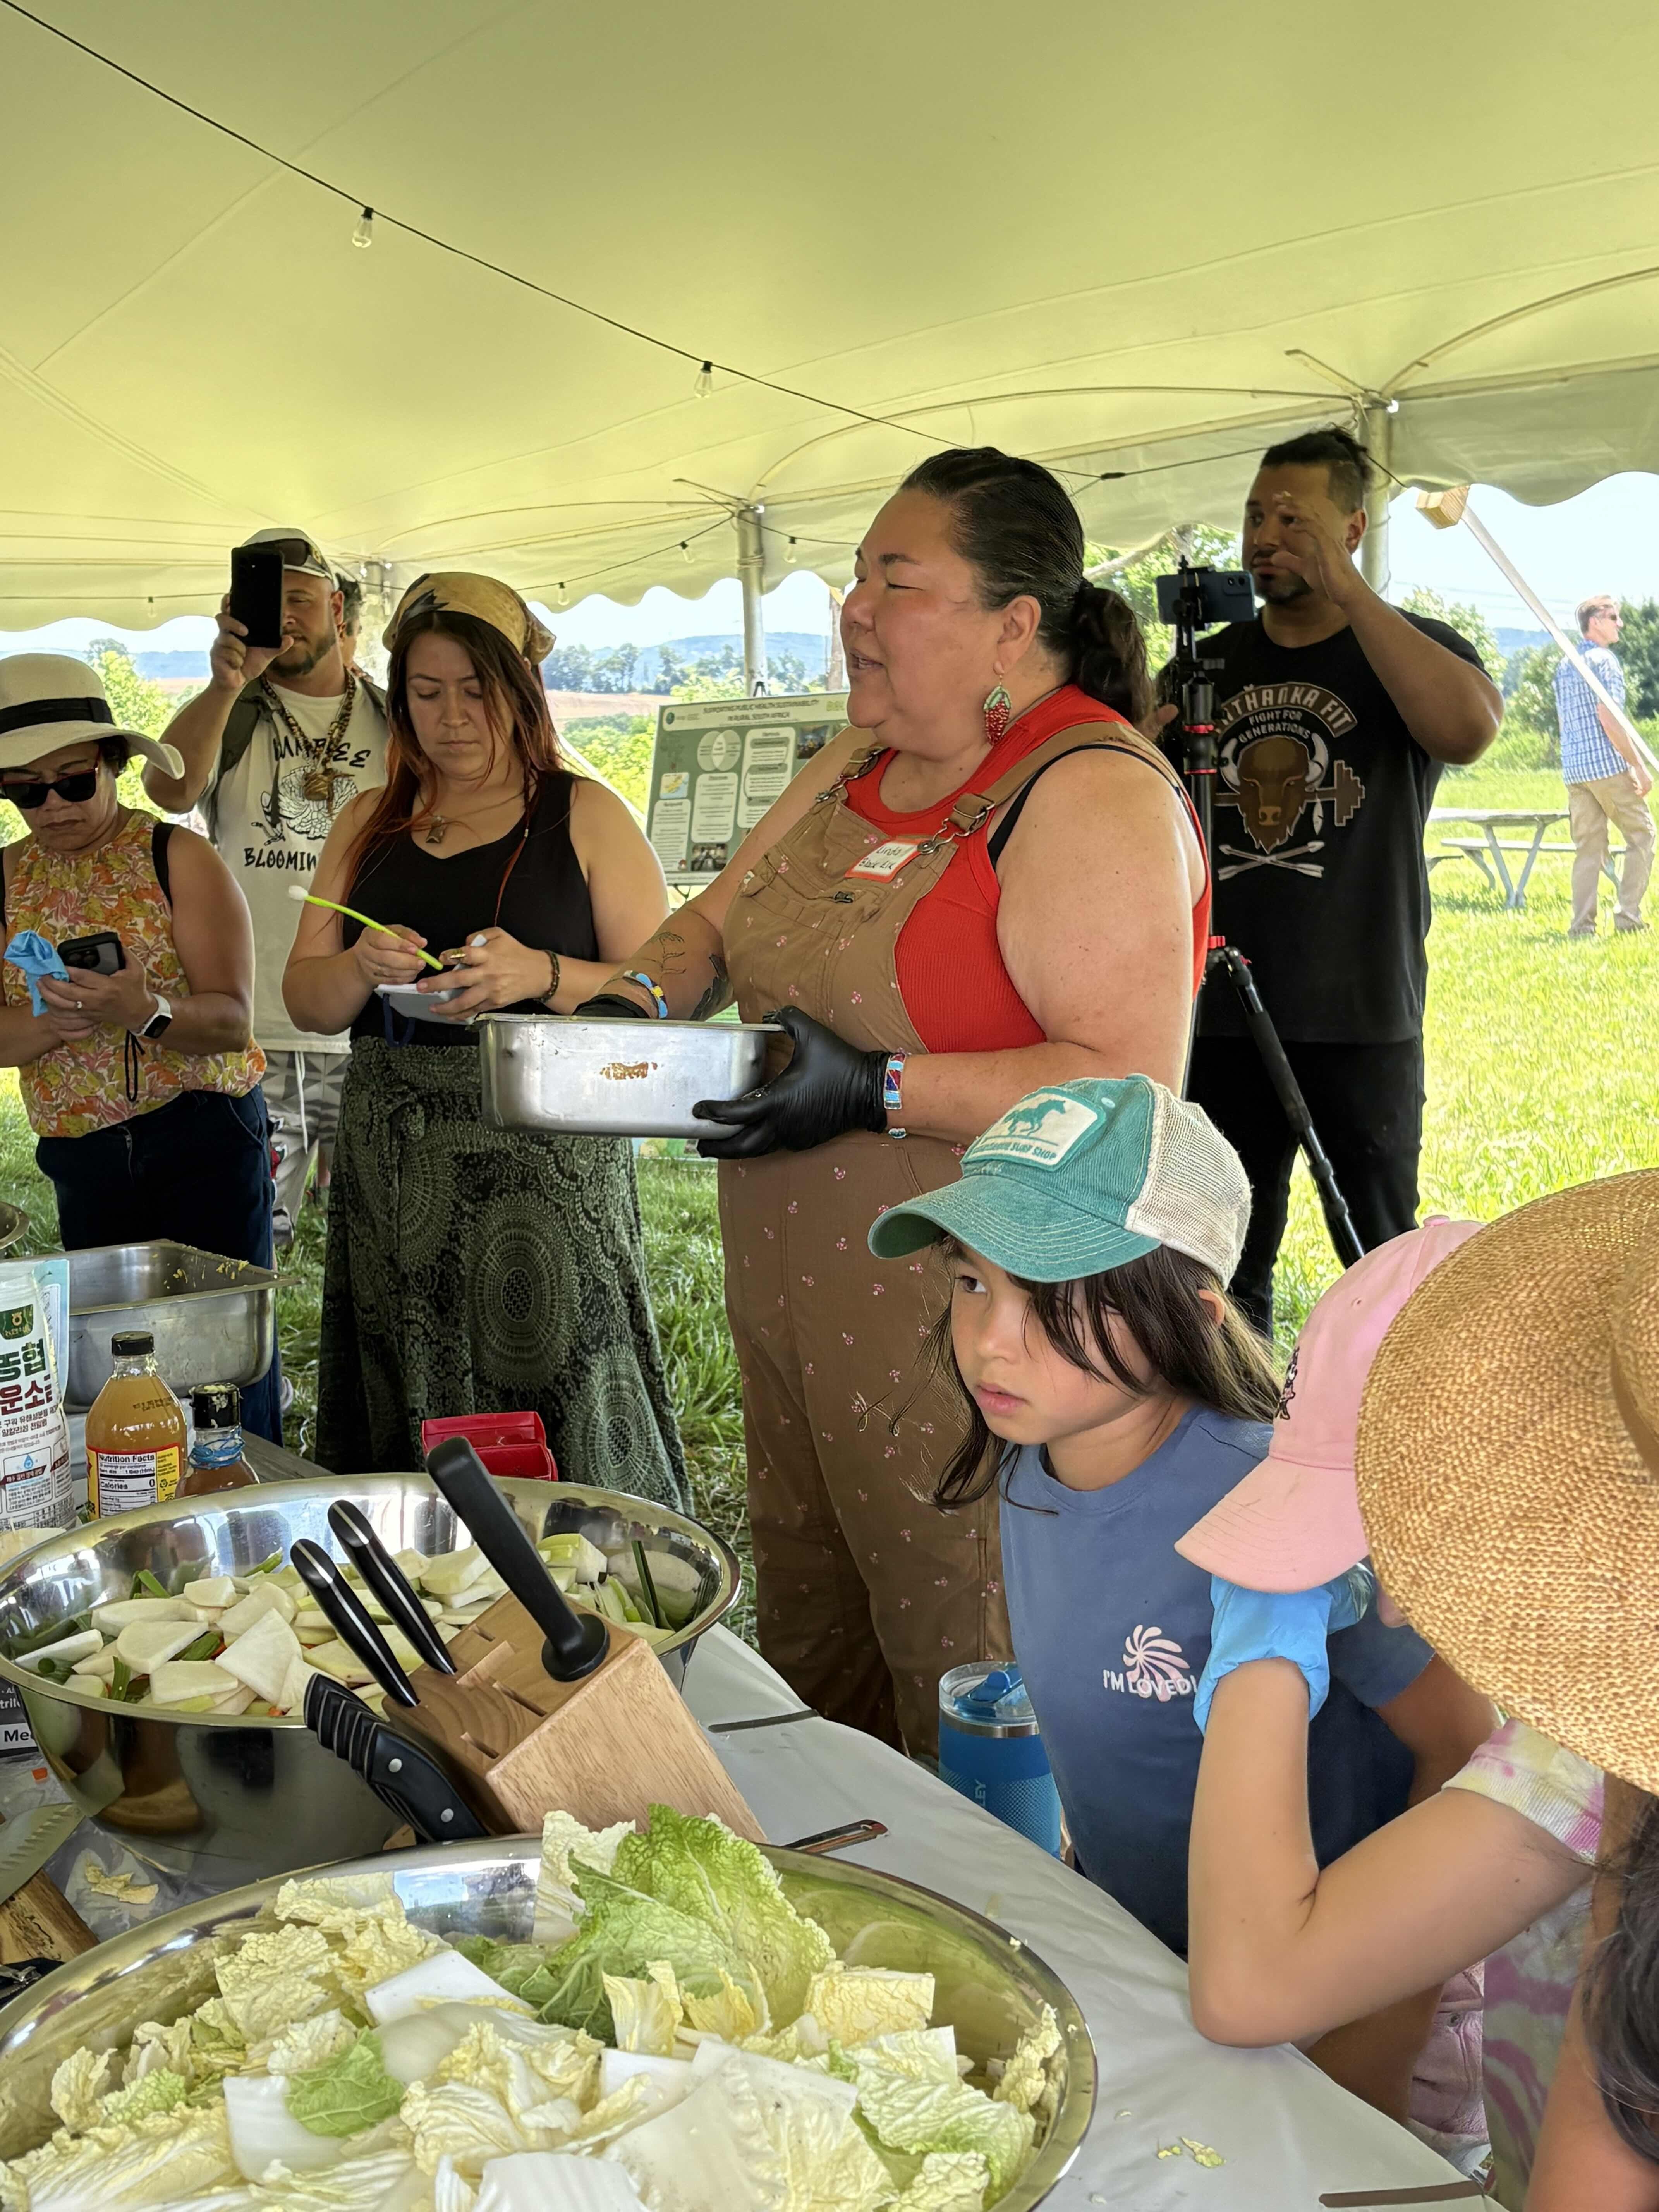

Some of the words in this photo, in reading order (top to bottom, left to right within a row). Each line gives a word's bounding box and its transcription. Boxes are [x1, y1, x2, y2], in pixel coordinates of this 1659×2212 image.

[1249, 710, 1281, 725] FIGHT
[1283, 709, 1302, 721] FOR
[1320, 699, 1352, 729] FIT
[1239, 721, 1311, 743] GENERATIONS
[1010, 1142, 1032, 1153] SURF
[1032, 1147, 1057, 1160] SHOP
[99, 1454, 130, 1463] Nutrition
[101, 1481, 128, 1490] Calories
[149, 1479, 155, 1487] 0
[1103, 1669, 1125, 1693] I'M
